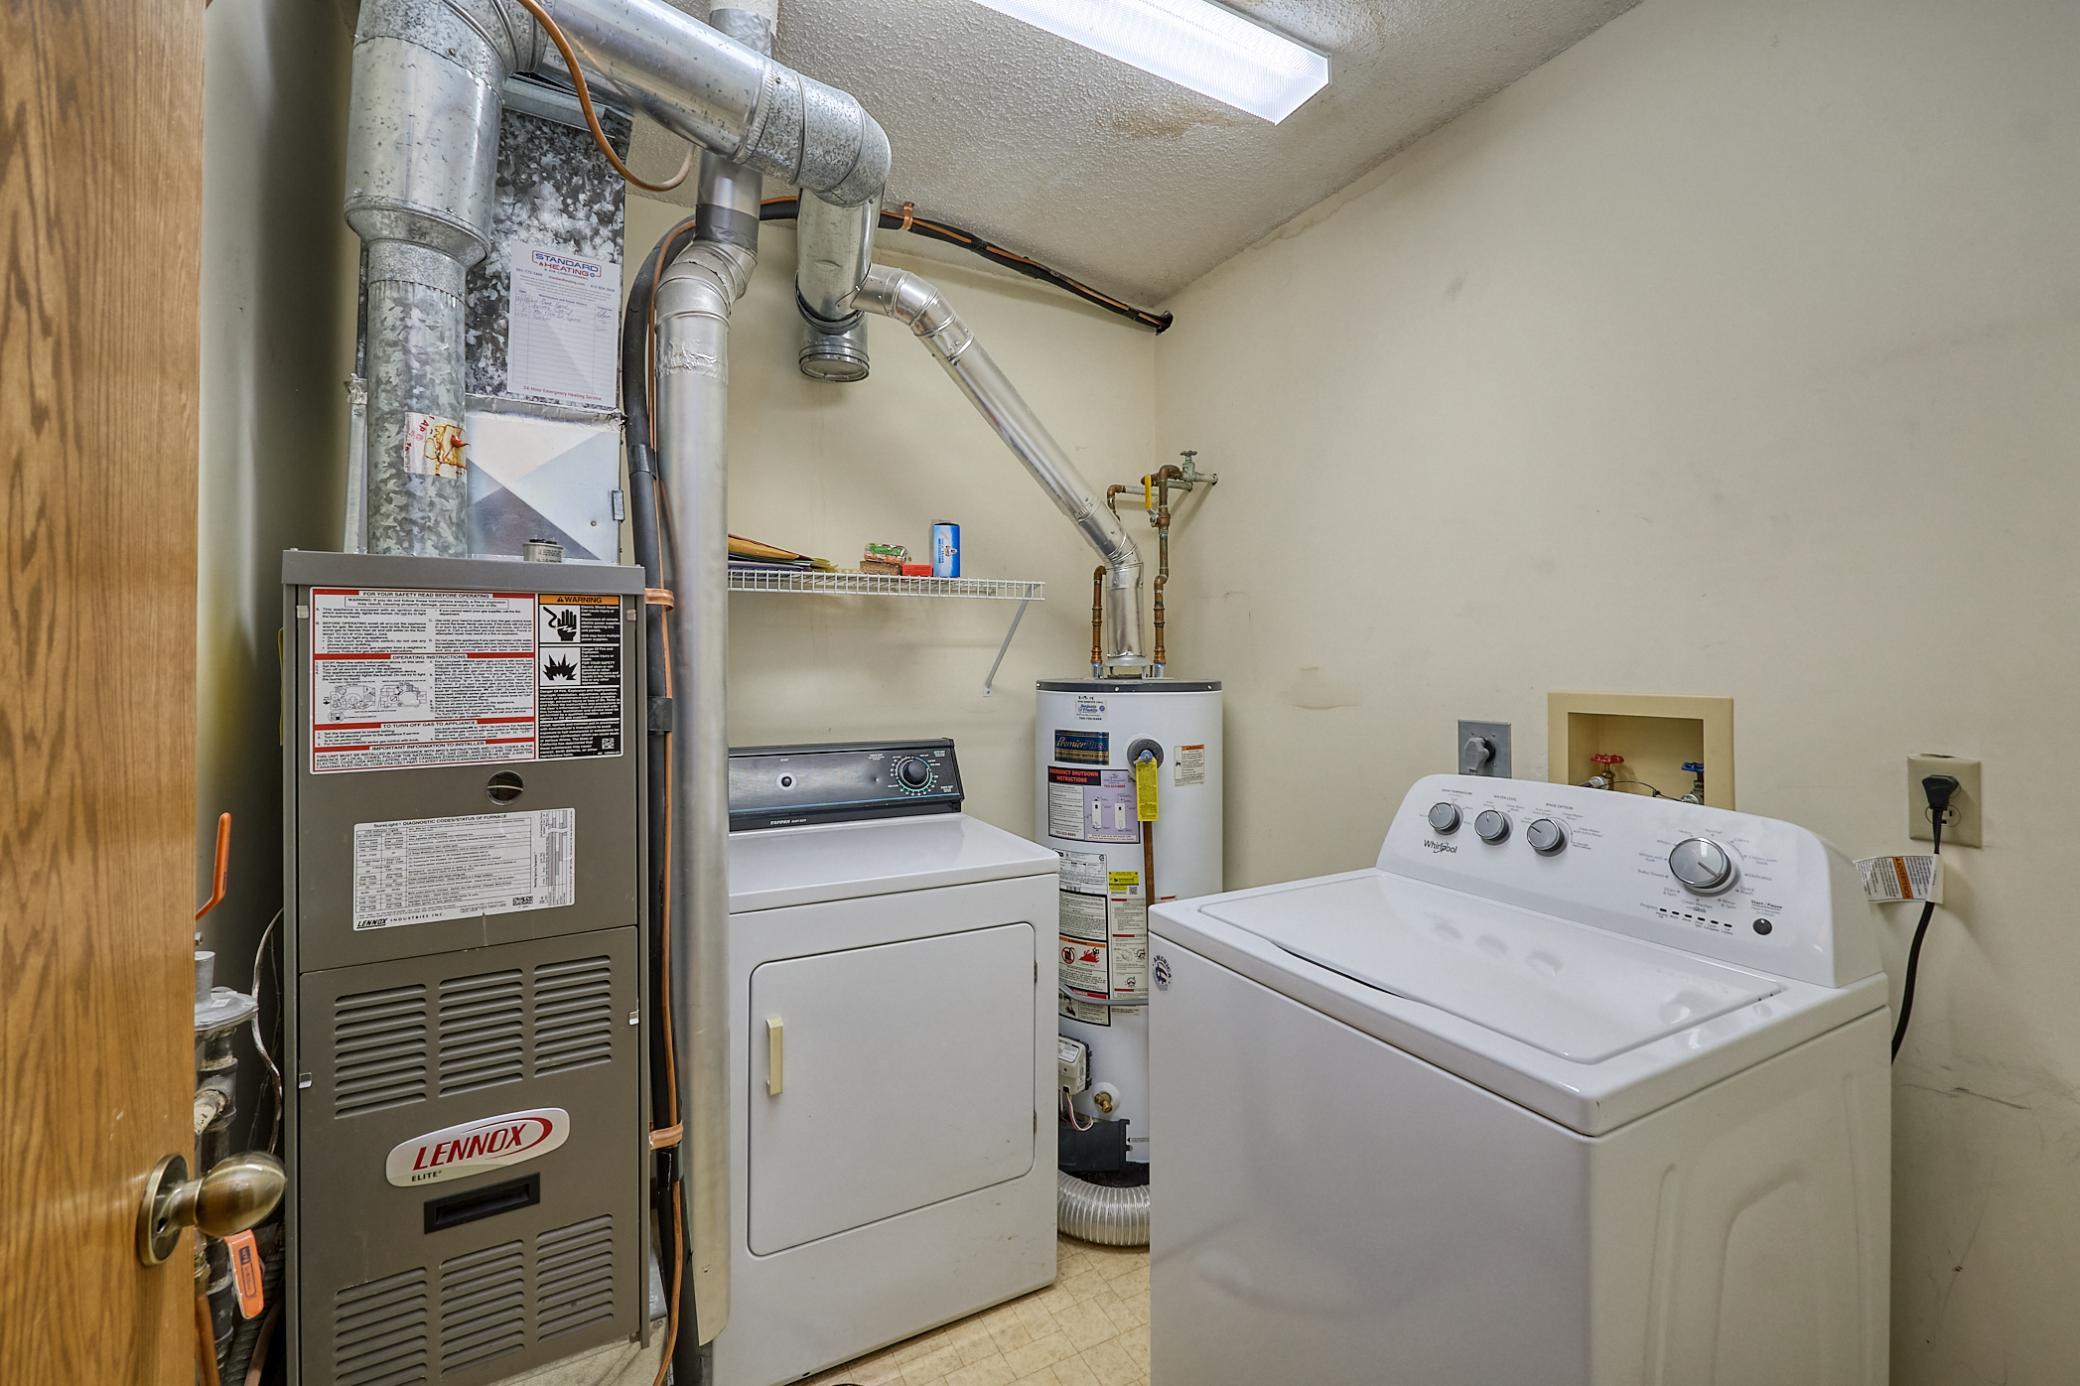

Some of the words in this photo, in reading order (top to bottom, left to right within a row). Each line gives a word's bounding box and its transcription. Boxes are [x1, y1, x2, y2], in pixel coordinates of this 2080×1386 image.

[535, 253, 599, 272] STANDARD
[543, 263, 589, 277] HEATING
[564, 596, 602, 604] WARNING
[436, 816, 475, 824] CODES/STATUS
[1423, 838, 1458, 855] Whirlpool
[357, 918, 388, 928] LENNOX
[390, 914, 429, 922] INDUSTRIES
[412, 1123, 527, 1171] LENNOX
[411, 1172, 437, 1182] ELITE
